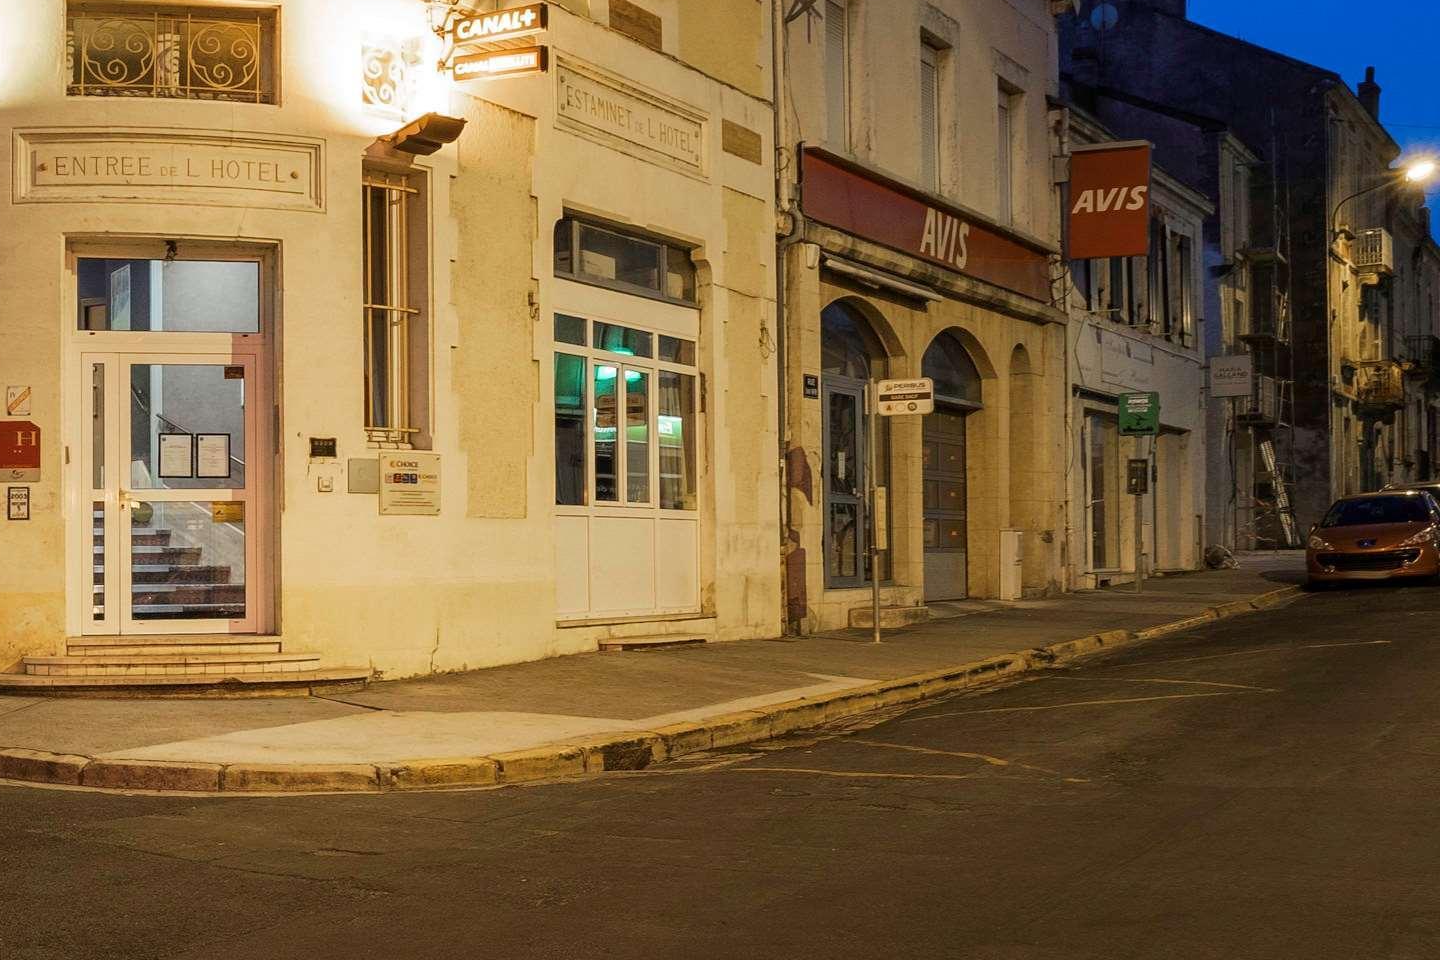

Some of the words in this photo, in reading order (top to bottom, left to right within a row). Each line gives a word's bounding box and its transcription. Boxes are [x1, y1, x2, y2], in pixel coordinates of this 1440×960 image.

[456, 8, 537, 39] CANAL+
[566, 85, 632, 130] ESTAMINET
[659, 120, 695, 154] HOTEL
[54, 155, 153, 177] ENTREE
[160, 165, 177, 177] DE
[185, 157, 201, 178] L
[210, 158, 287, 183] HOTEL
[1071, 185, 1149, 214] AVIS
[920, 206, 970, 270] AVIS
[17, 431, 36, 446] H
